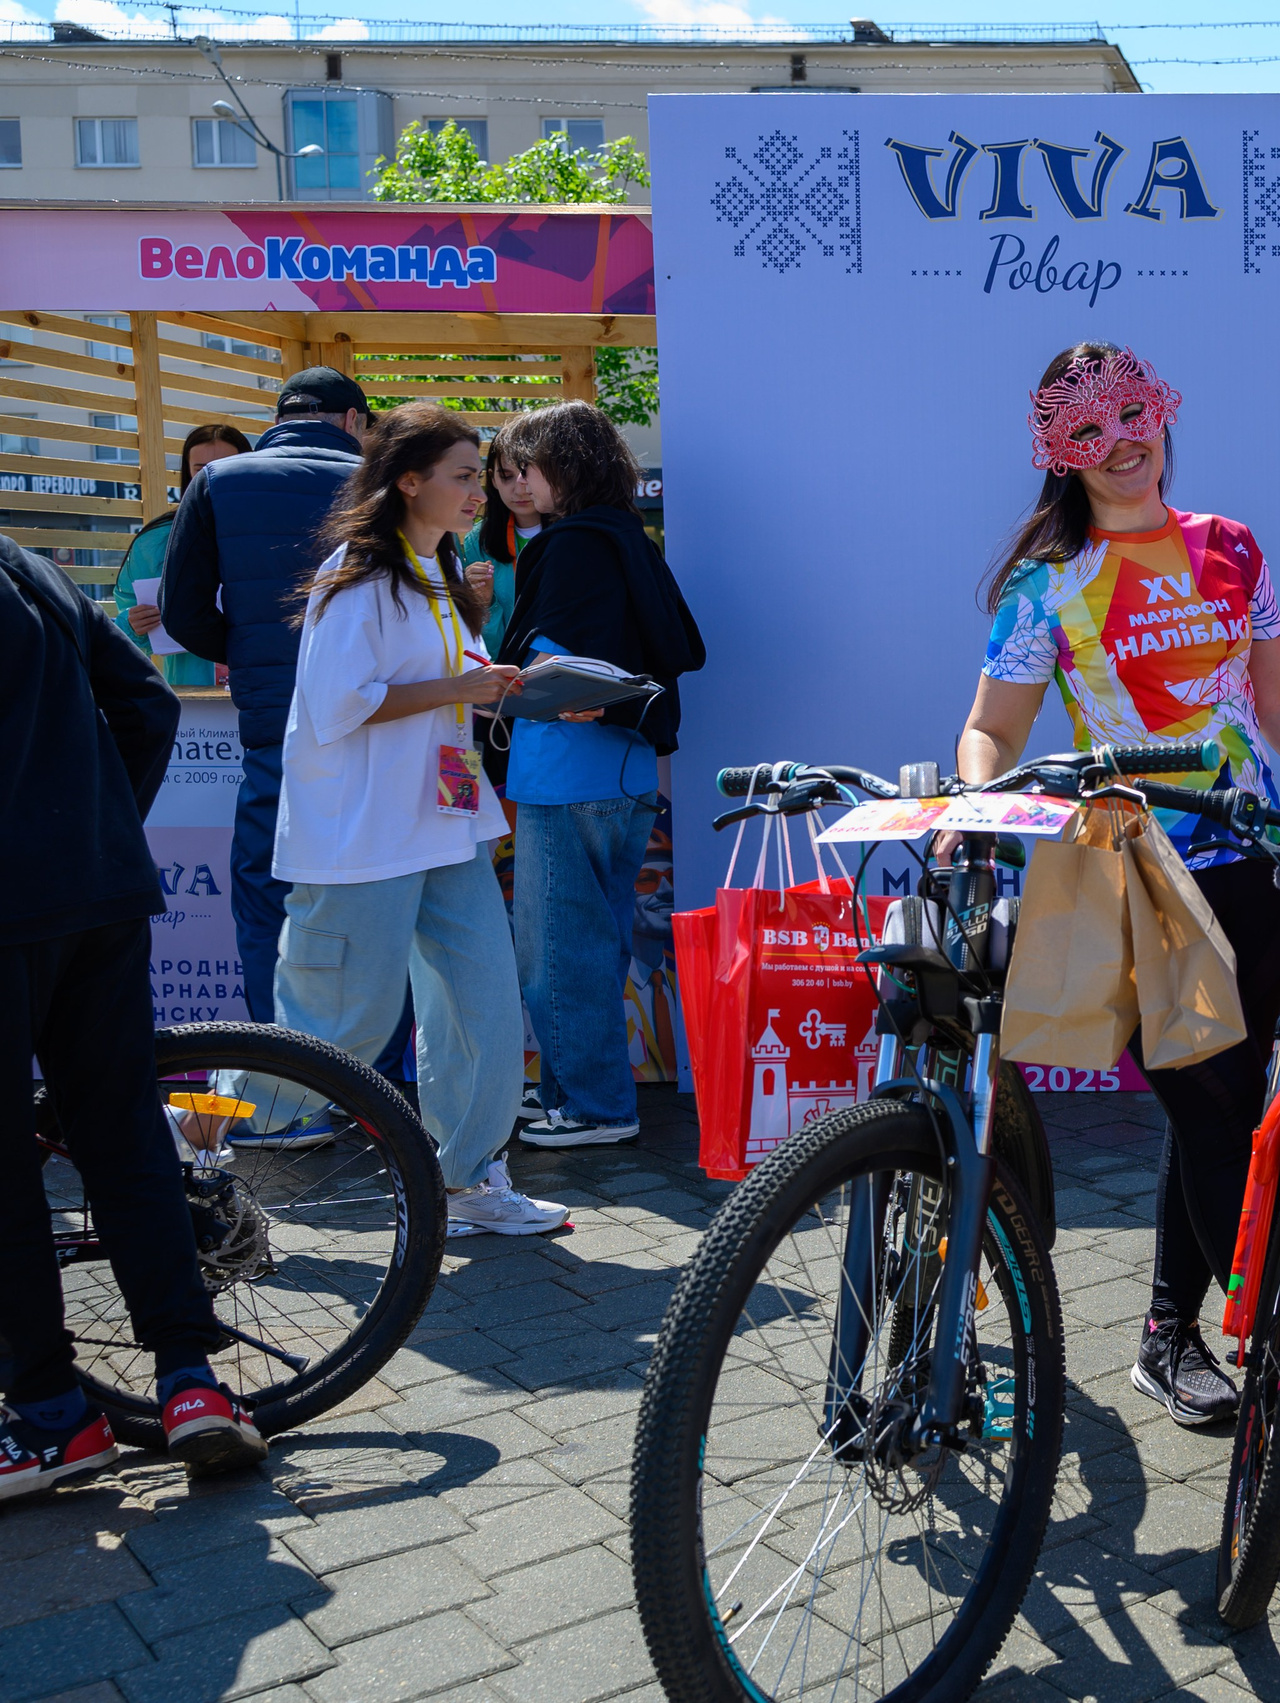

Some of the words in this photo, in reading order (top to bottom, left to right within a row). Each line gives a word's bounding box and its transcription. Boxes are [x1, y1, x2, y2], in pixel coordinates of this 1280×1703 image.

[884, 131, 1224, 223] VIVA
[140, 236, 496, 287] ВелоКоманда
[984, 234, 1121, 308] Ровар
[1139, 572, 1191, 605] XV
[1129, 599, 1231, 627] МАРАФОН
[199, 728, 240, 738] Климат
[185, 772, 218, 784] 2009
[763, 929, 808, 946] BSB
[832, 932, 883, 947] Bank
[806, 979, 815, 987] 20
[816, 979, 824, 987] 40
[1025, 1066, 1121, 1092] 2025
[173, 1398, 205, 1417] FILA
[1, 1435, 23, 1460] FILA
